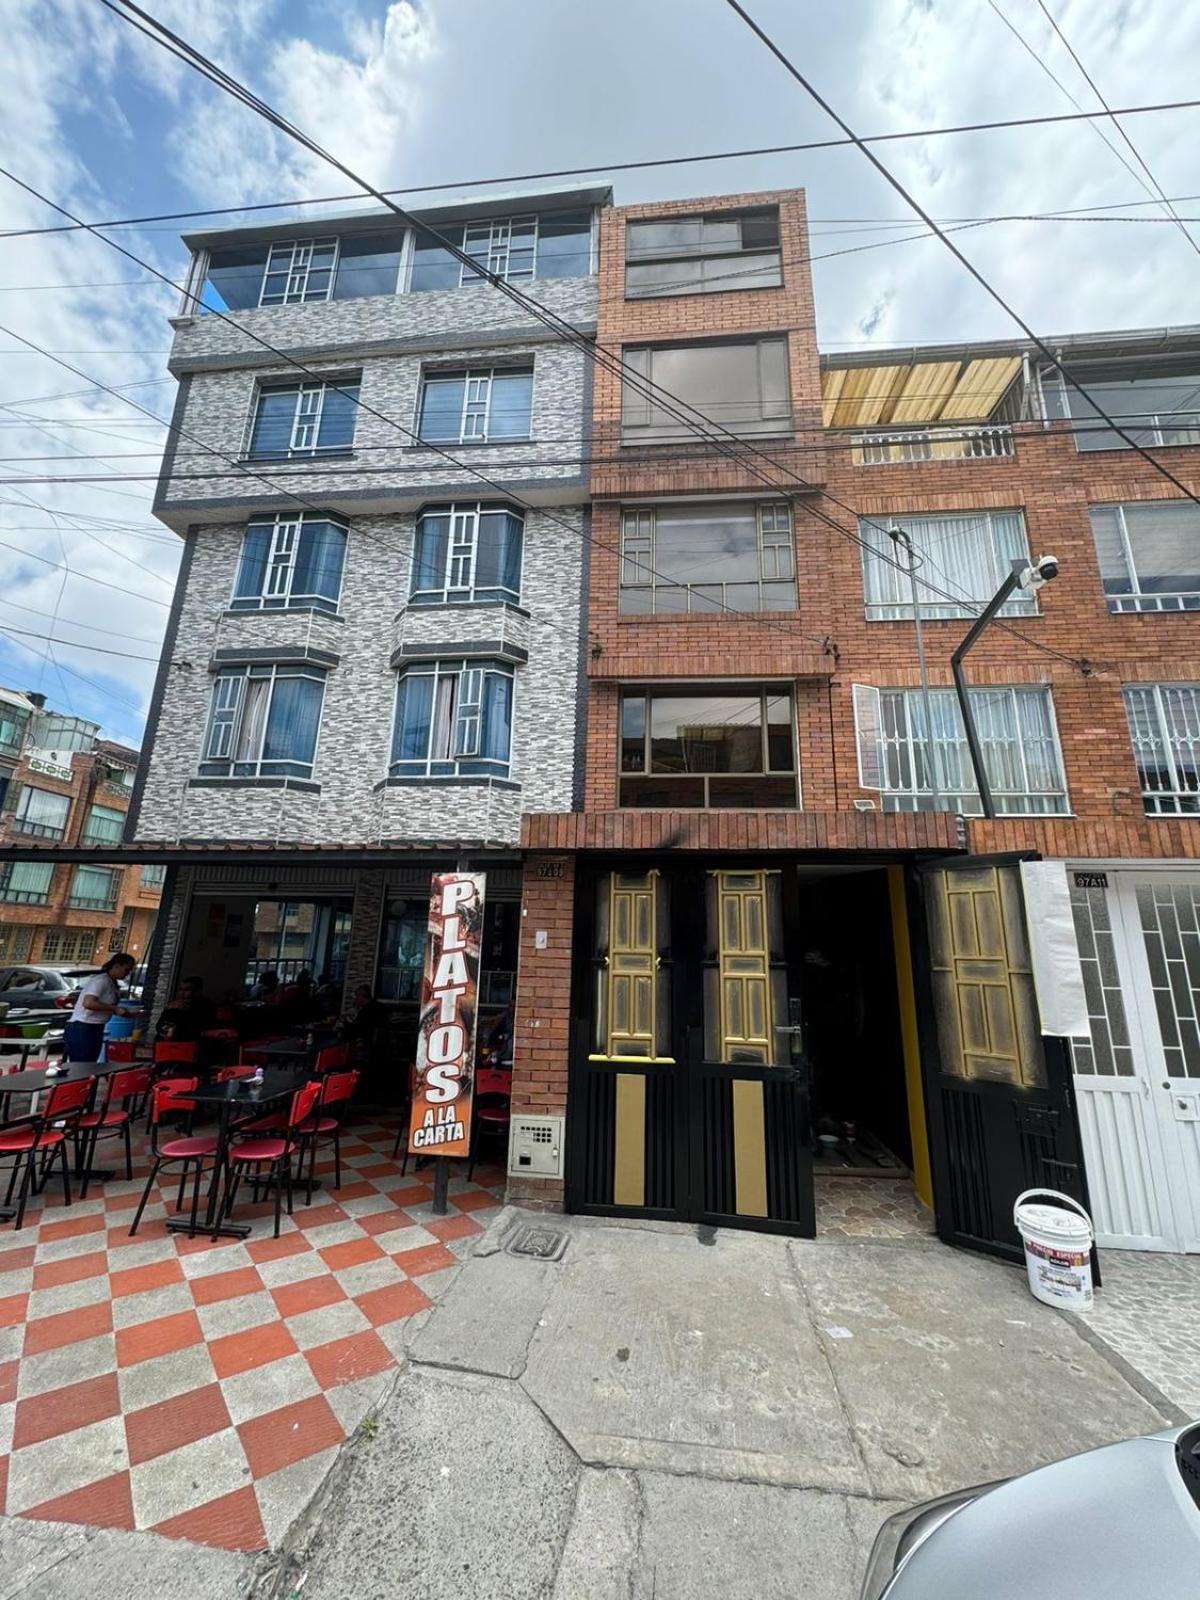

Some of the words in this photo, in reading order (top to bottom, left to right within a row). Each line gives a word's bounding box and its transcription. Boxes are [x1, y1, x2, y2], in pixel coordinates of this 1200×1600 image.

[425, 882, 474, 1103] PLATOS
[424, 1109, 434, 1127] A
[437, 1105, 456, 1124] LA
[413, 1122, 464, 1147] CARTA
